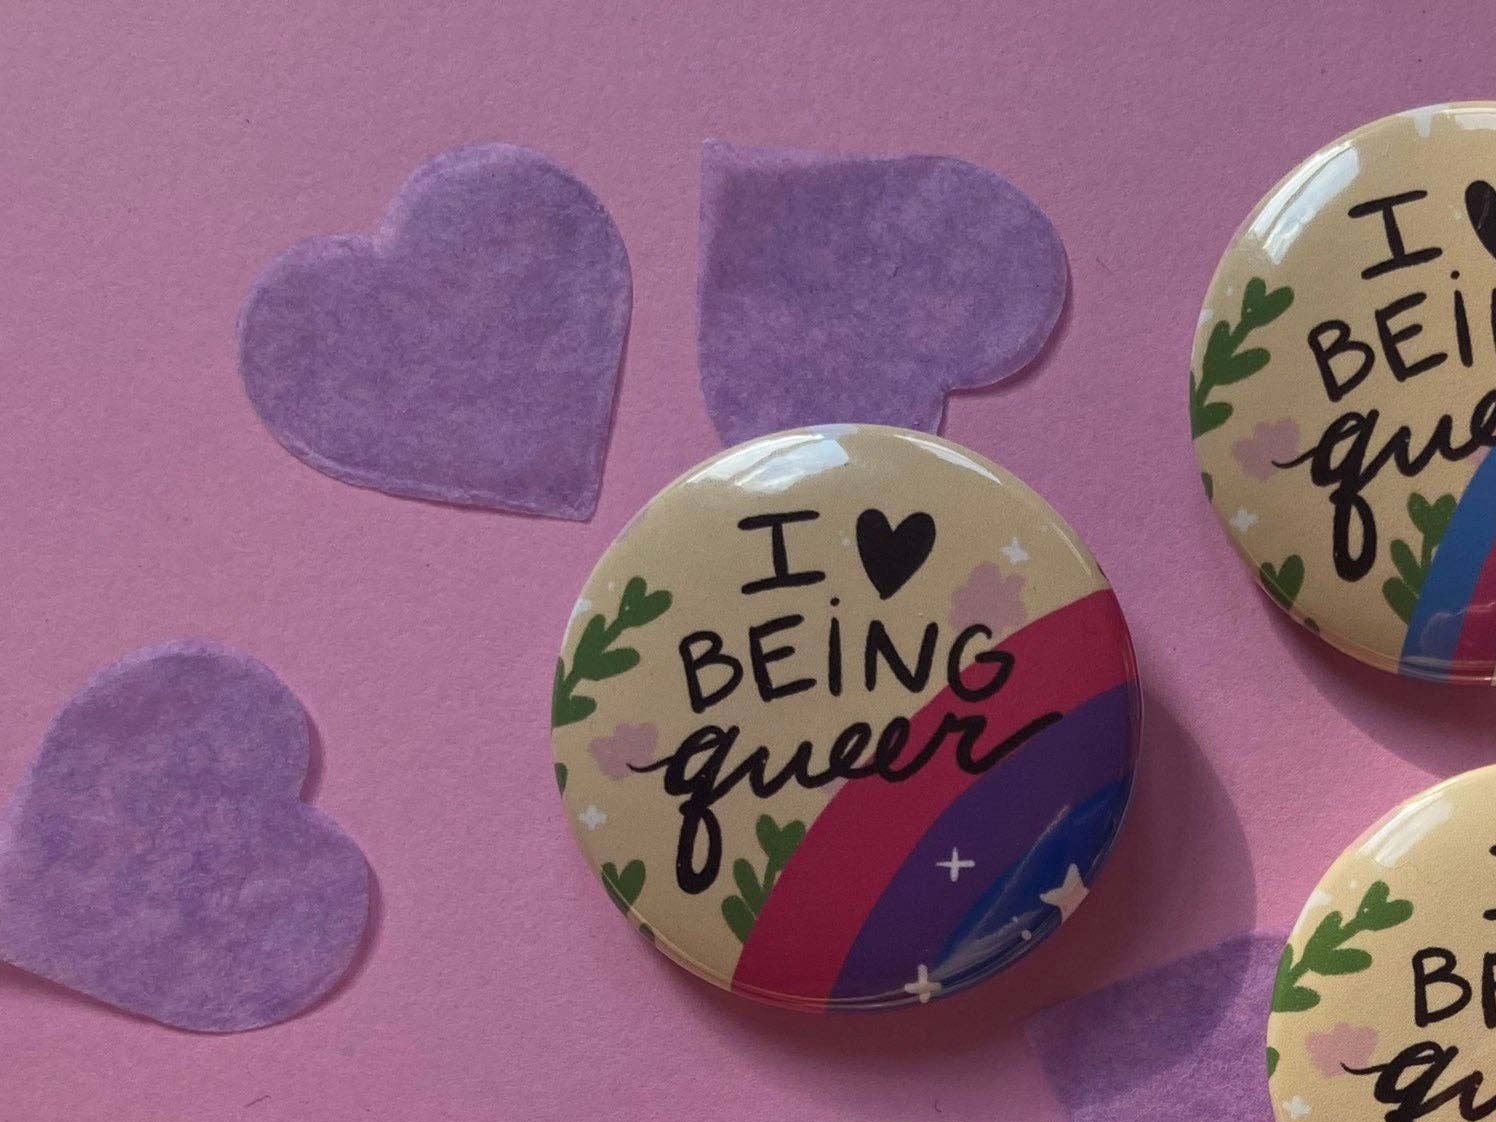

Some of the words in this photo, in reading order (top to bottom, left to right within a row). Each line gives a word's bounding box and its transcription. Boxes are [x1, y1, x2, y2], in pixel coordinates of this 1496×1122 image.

[1348, 191, 1443, 280] I
[738, 510, 826, 595] I
[628, 710, 1062, 893] queer
